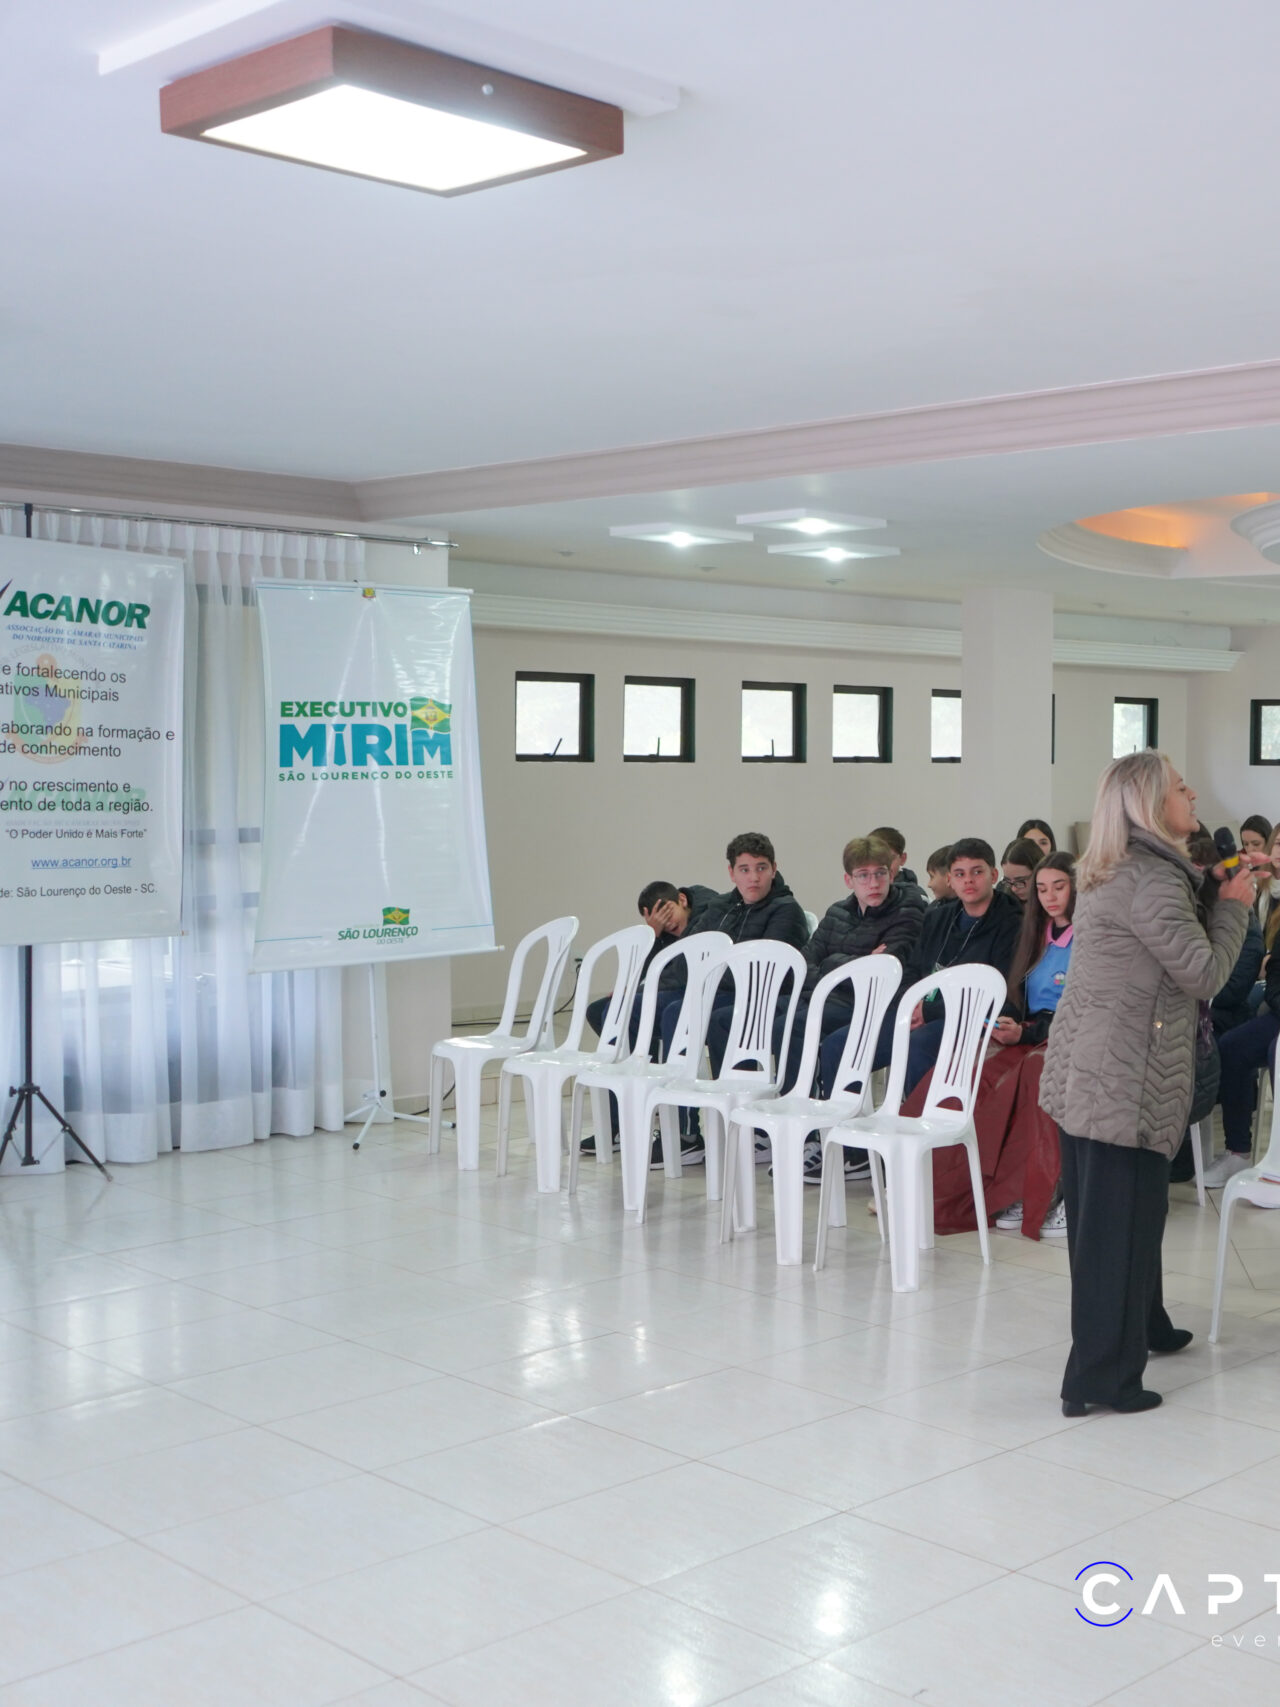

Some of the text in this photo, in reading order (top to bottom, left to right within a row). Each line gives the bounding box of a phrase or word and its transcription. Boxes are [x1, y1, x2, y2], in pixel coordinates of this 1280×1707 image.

[3, 590, 151, 629] ACANOR
[2, 662, 127, 683] e fortalecendo os
[45, 684, 119, 703] Municipais
[280, 701, 408, 718] EXECUTIVO
[76, 727, 94, 738] na
[98, 725, 161, 742] formação
[165, 729, 175, 740] e
[21, 742, 122, 757] conhecimento
[278, 770, 454, 782] SÃO LOURENÇO DO OESTE
[9, 780, 28, 791] no
[32, 779, 119, 793] crescimento
[122, 782, 131, 793] e
[37, 798, 57, 811] de
[61, 798, 91, 811] toda
[95, 801, 104, 811] a
[108, 799, 153, 815] região.
[21, 829, 53, 839] Poder
[55, 829, 84, 839] Unido
[86, 828, 93, 838] é
[95, 829, 118, 839] Mais
[31, 856, 132, 870] www.acanor.org.br
[16, 886, 37, 898] São
[40, 885, 87, 898] Lourenço
[89, 885, 101, 895] do
[103, 884, 132, 895] Oeste
[140, 883, 158, 894] SC.
[337, 927, 360, 941] SÃO
[363, 926, 419, 939] LOURENÇO
